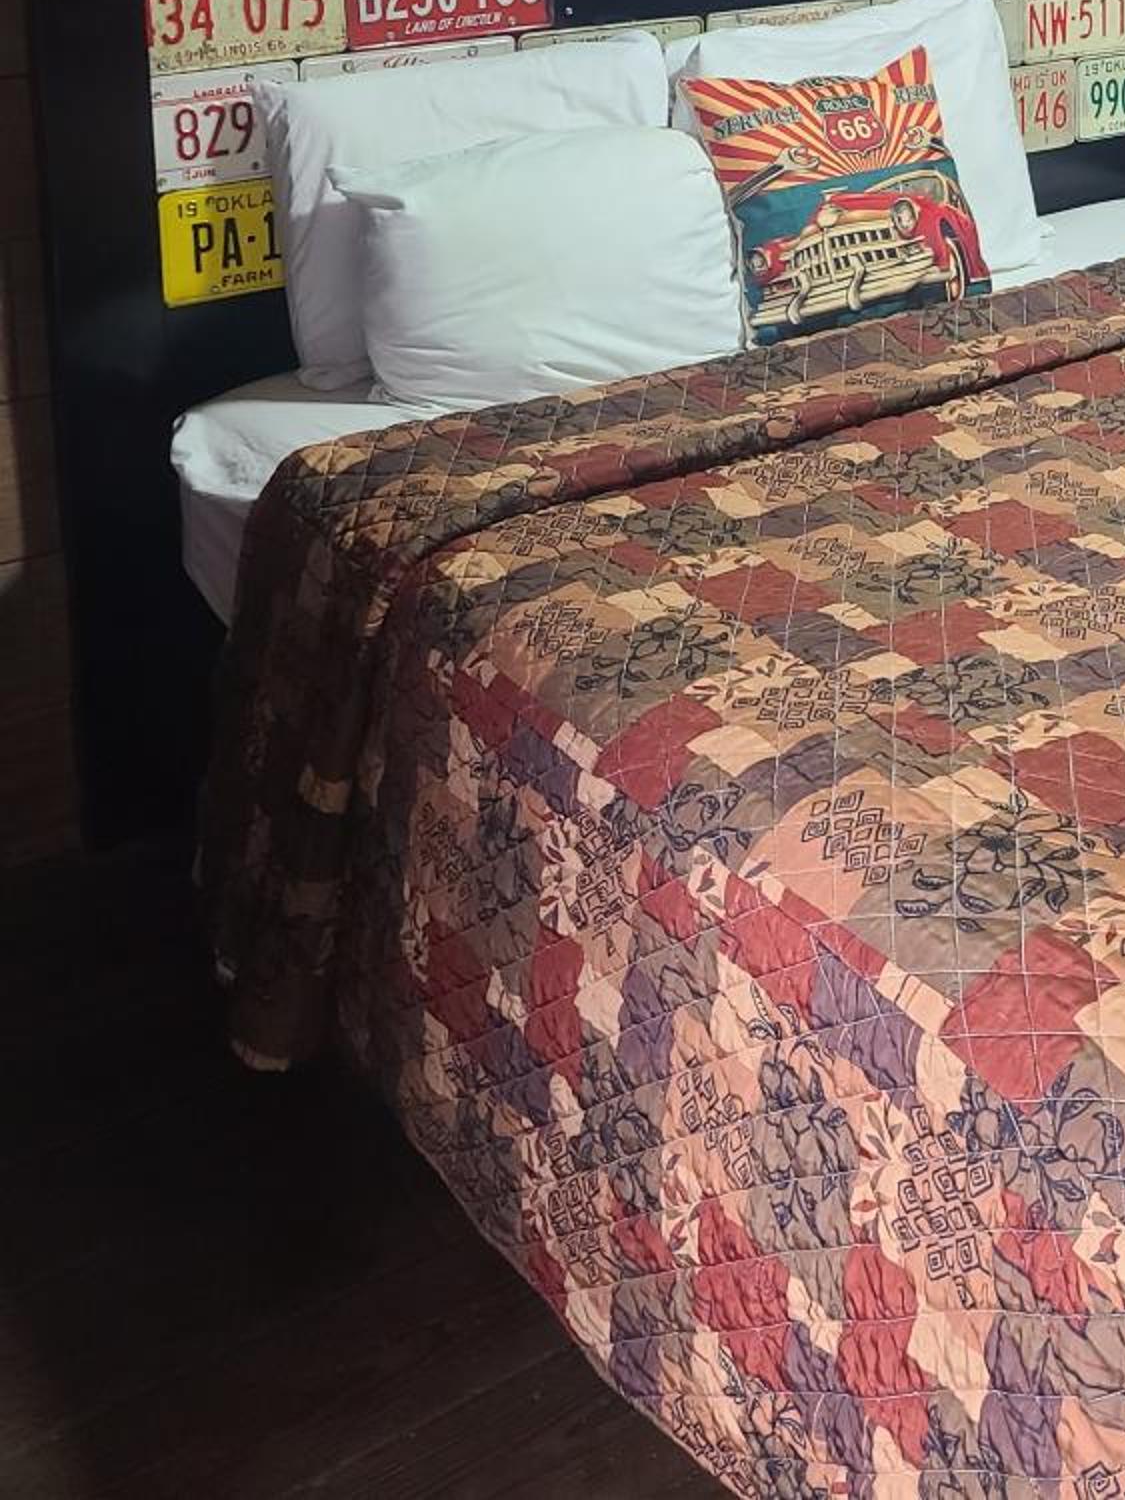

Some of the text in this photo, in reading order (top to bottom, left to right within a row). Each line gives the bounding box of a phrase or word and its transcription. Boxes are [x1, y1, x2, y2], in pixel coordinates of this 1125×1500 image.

[405, 20, 434, 35] LAND
[438, 17, 453, 31] OF
[1052, 70, 1067, 86] OK
[175, 102, 254, 160] 829
[837, 116, 872, 141] 66
[222, 269, 272, 287] FARM
